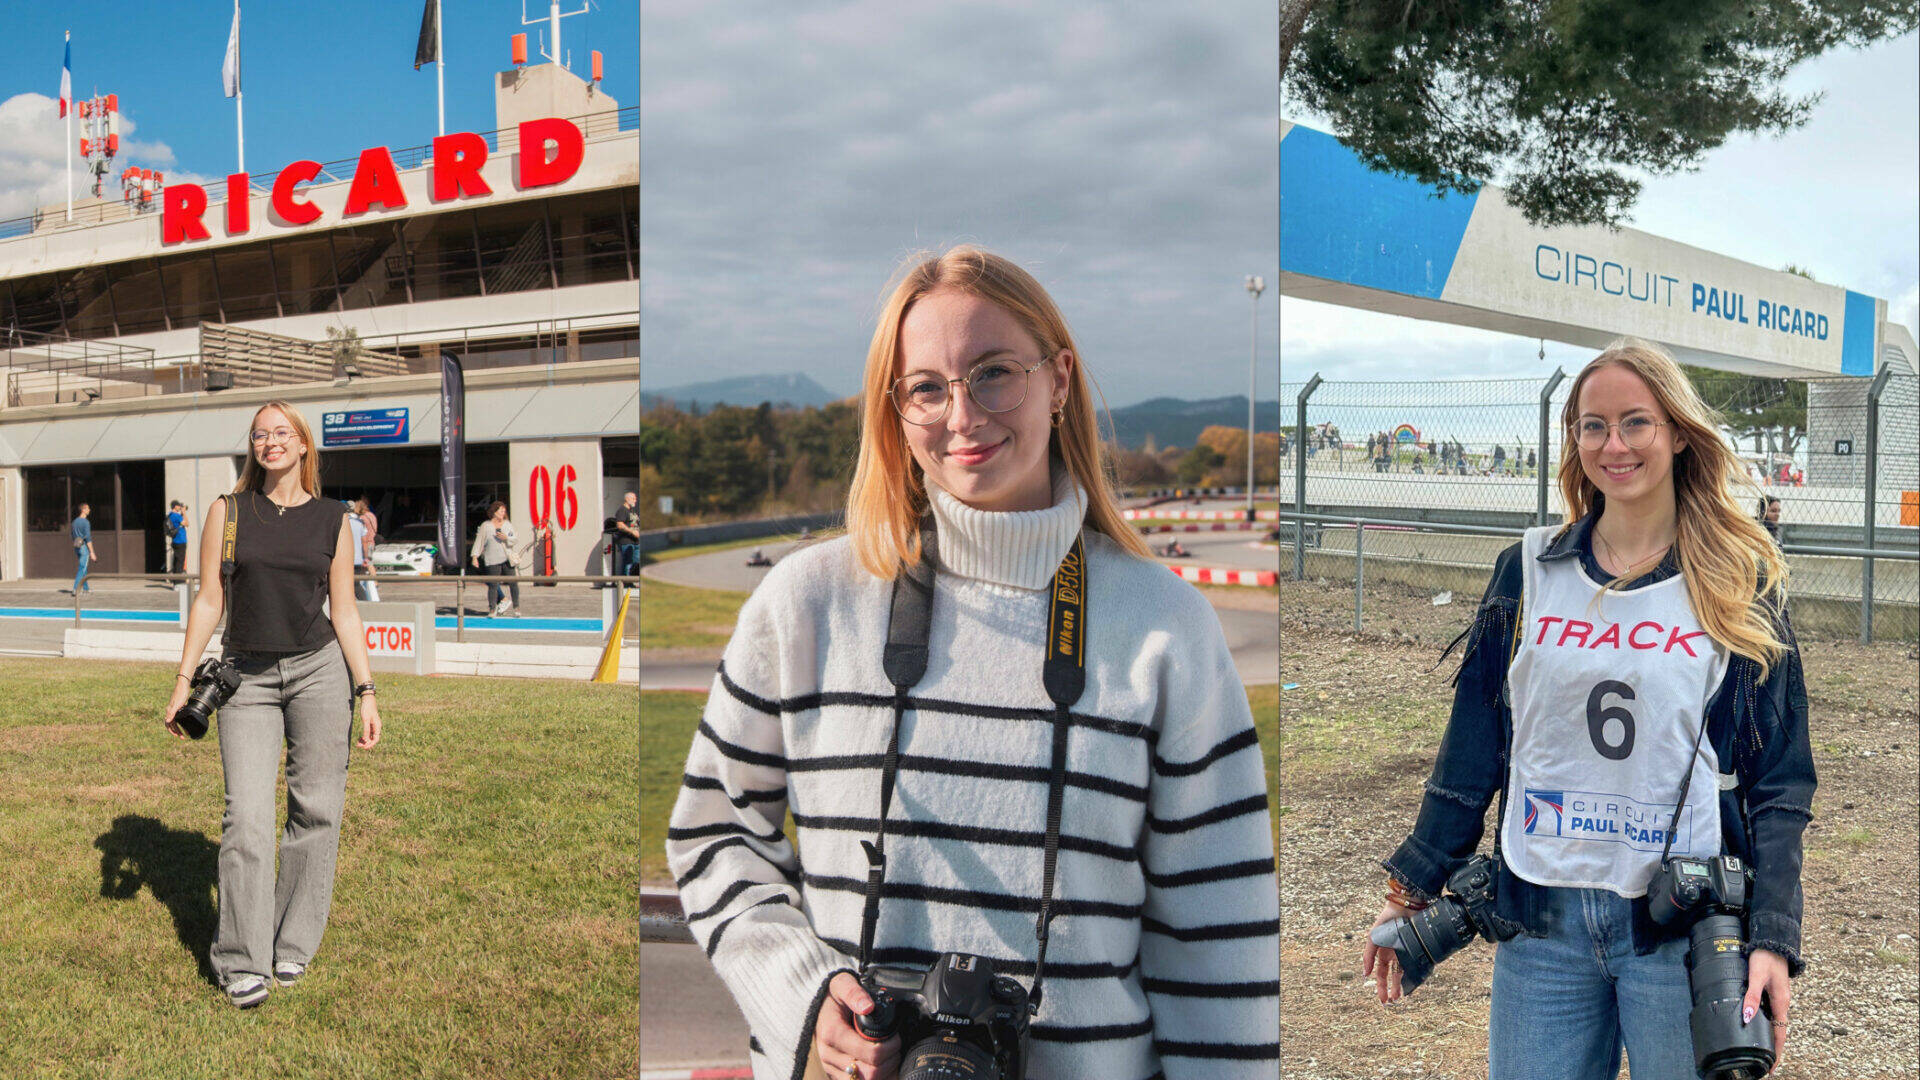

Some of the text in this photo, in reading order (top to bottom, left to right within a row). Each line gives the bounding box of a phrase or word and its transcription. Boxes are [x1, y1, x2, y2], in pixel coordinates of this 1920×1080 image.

[163, 117, 584, 244] RICARD
[1536, 244, 1829, 341] CIRCUIT PAUL RICARD
[325, 413, 346, 425] 38
[529, 464, 578, 531] 06
[1059, 609, 1075, 656] Nikon
[1536, 616, 1707, 658] TRACK
[1586, 679, 1636, 760] 6
[1571, 817, 1618, 833] PAUL
[936, 1013, 971, 1025] Nikon
